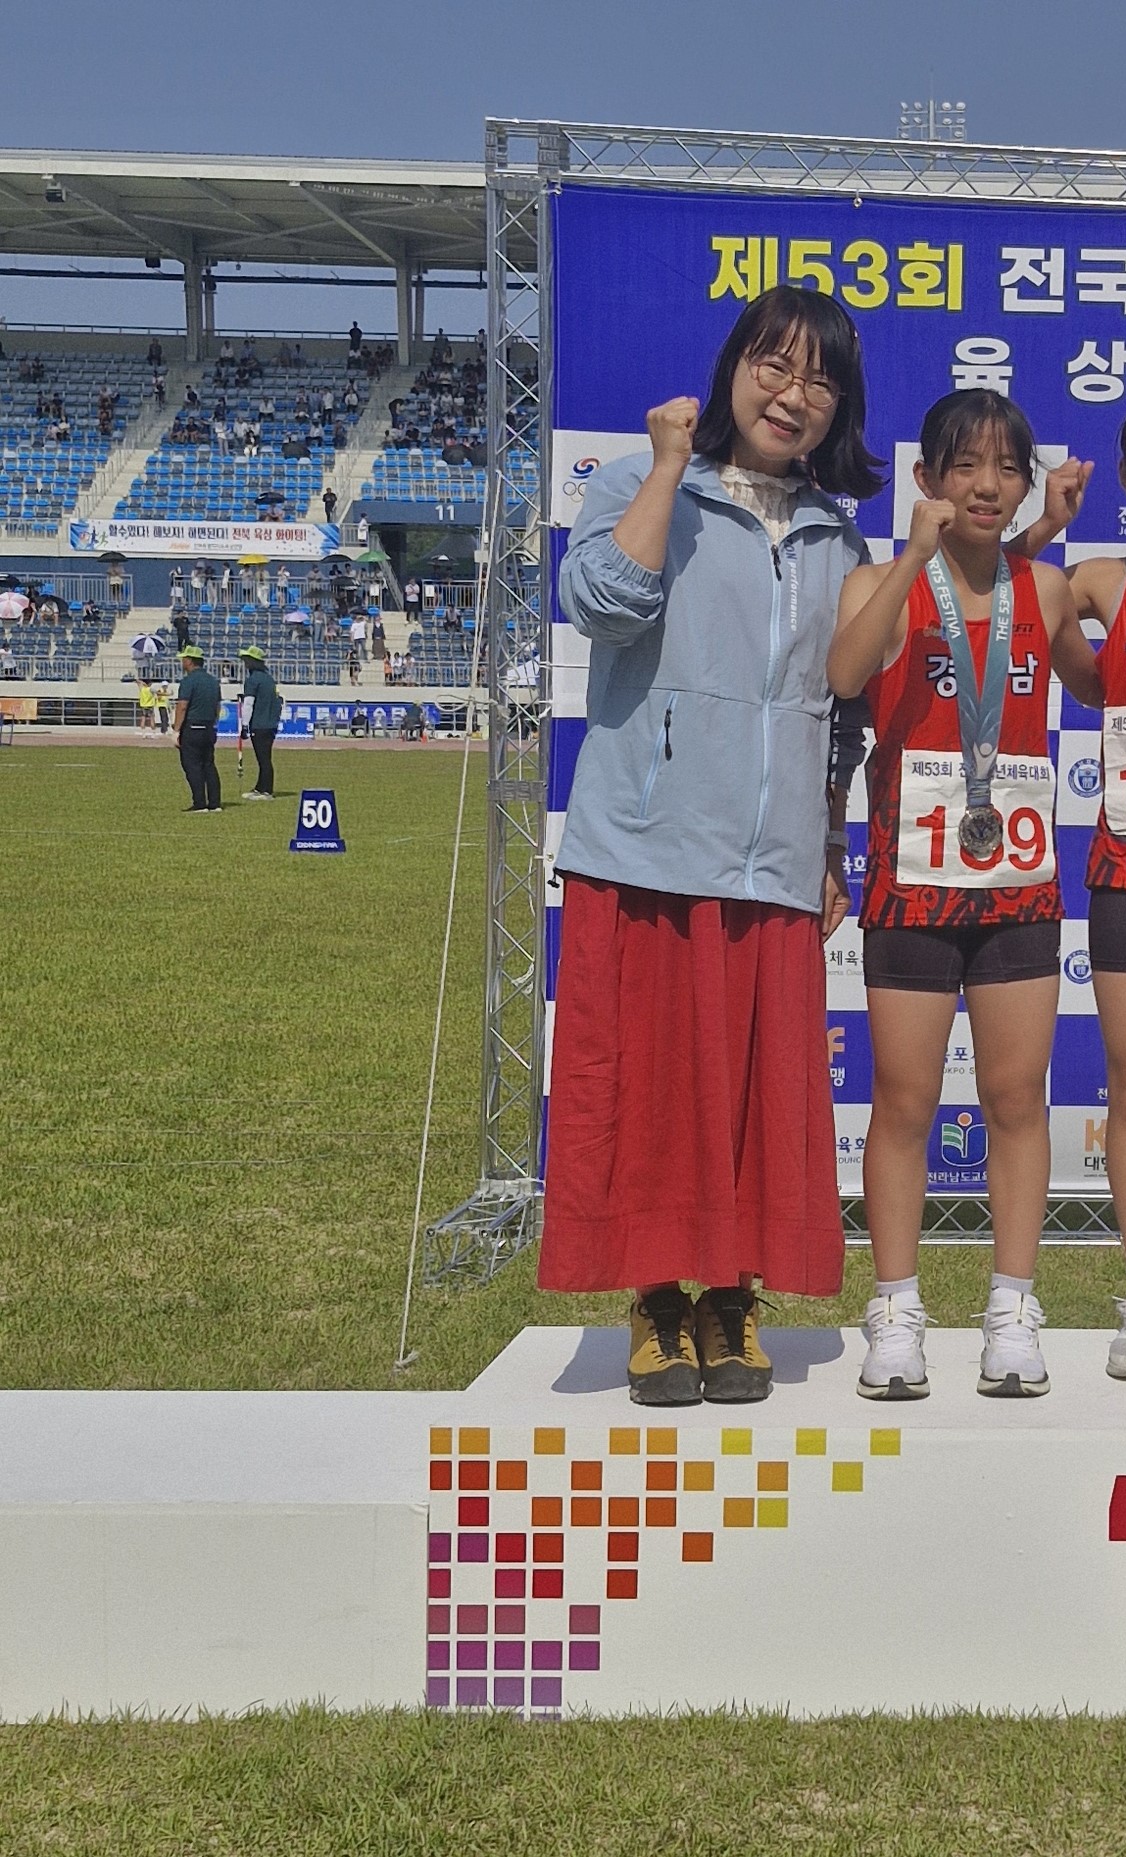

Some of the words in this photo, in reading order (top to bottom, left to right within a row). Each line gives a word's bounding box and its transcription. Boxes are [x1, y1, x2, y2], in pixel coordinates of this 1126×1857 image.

[708, 235, 965, 312] 제53회
[435, 504, 455, 521] 11
[911, 761, 953, 778] 제53회
[958, 762, 1051, 782] 전년체육대회
[302, 799, 333, 829] 50
